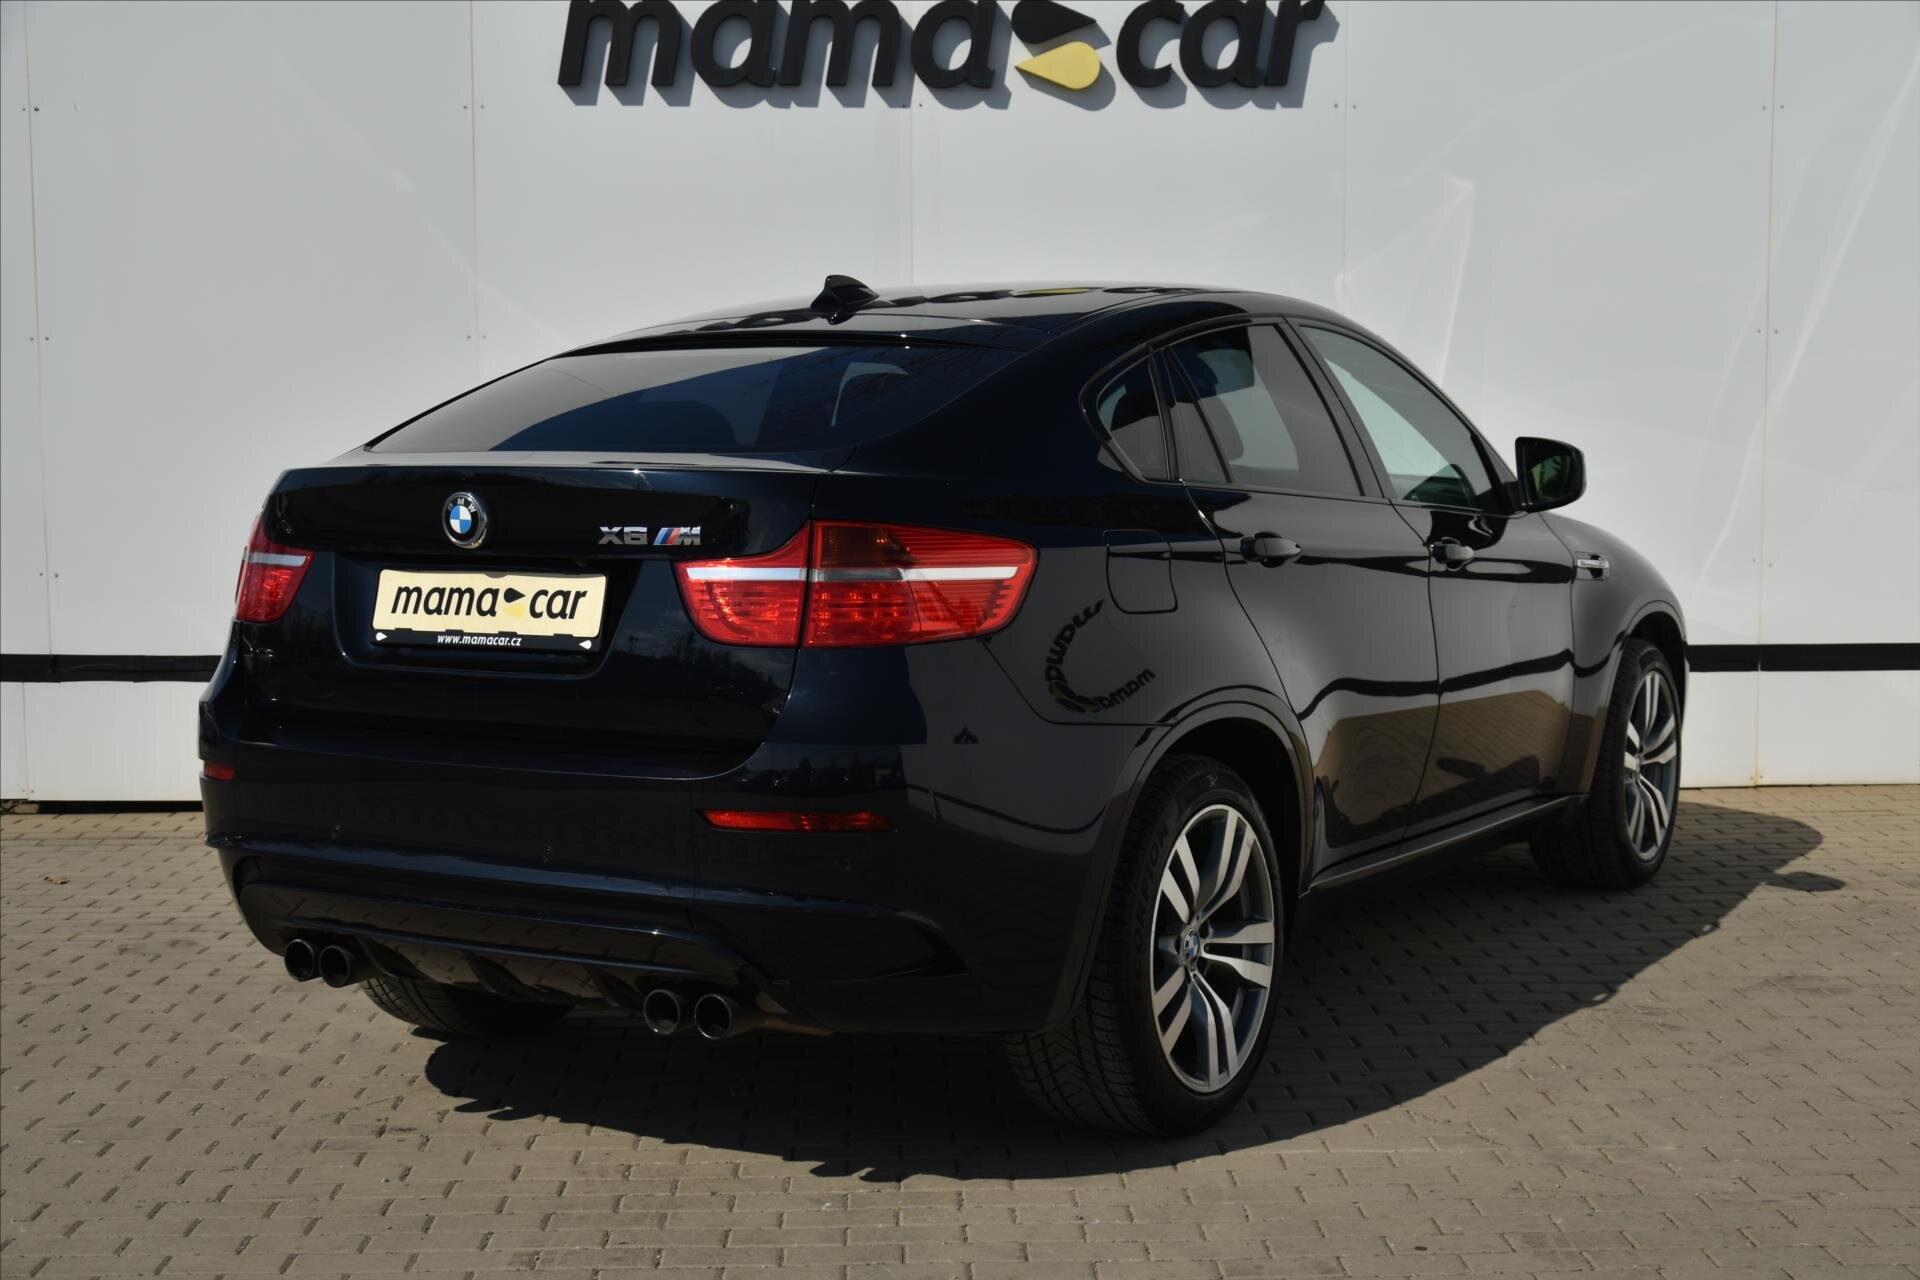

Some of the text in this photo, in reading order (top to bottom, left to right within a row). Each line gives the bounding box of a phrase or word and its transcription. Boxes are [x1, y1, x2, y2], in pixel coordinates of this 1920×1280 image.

[558, 0, 1325, 88] mama car
[447, 497, 477, 513] BMW
[598, 526, 648, 545] X6
[391, 586, 588, 619] mama car
[437, 635, 522, 646] www.mamacar.cz
